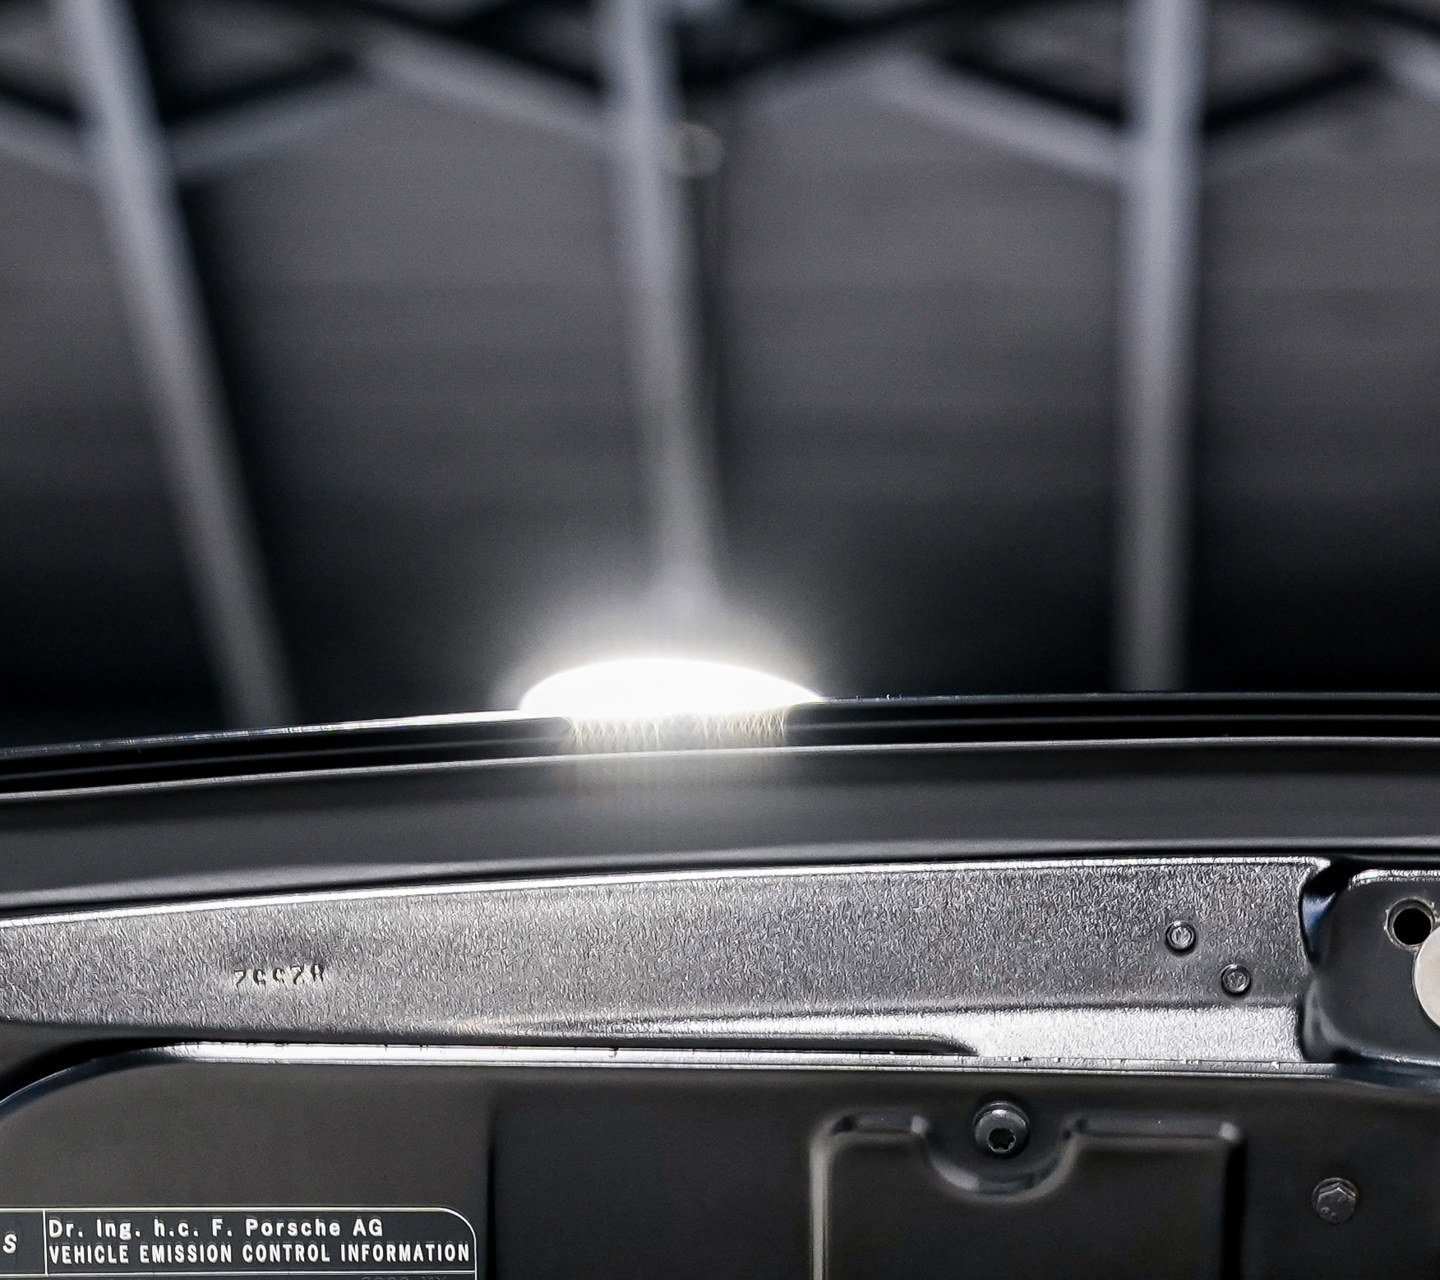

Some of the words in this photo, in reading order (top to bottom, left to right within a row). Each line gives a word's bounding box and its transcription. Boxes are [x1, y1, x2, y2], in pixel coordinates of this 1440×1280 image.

[49, 1220, 83, 1237] Dr.
[97, 1219, 140, 1240] Ing.
[154, 1218, 199, 1237] h.c.
[212, 1218, 233, 1237] F.
[245, 1218, 340, 1237] Porsche
[352, 1218, 383, 1237] AG
[3, 1233, 17, 1254] S
[49, 1245, 129, 1264] VEHICLE
[139, 1244, 232, 1264] EMISSION
[242, 1244, 330, 1263] CONTROL
[340, 1243, 469, 1262] INFORMATION
